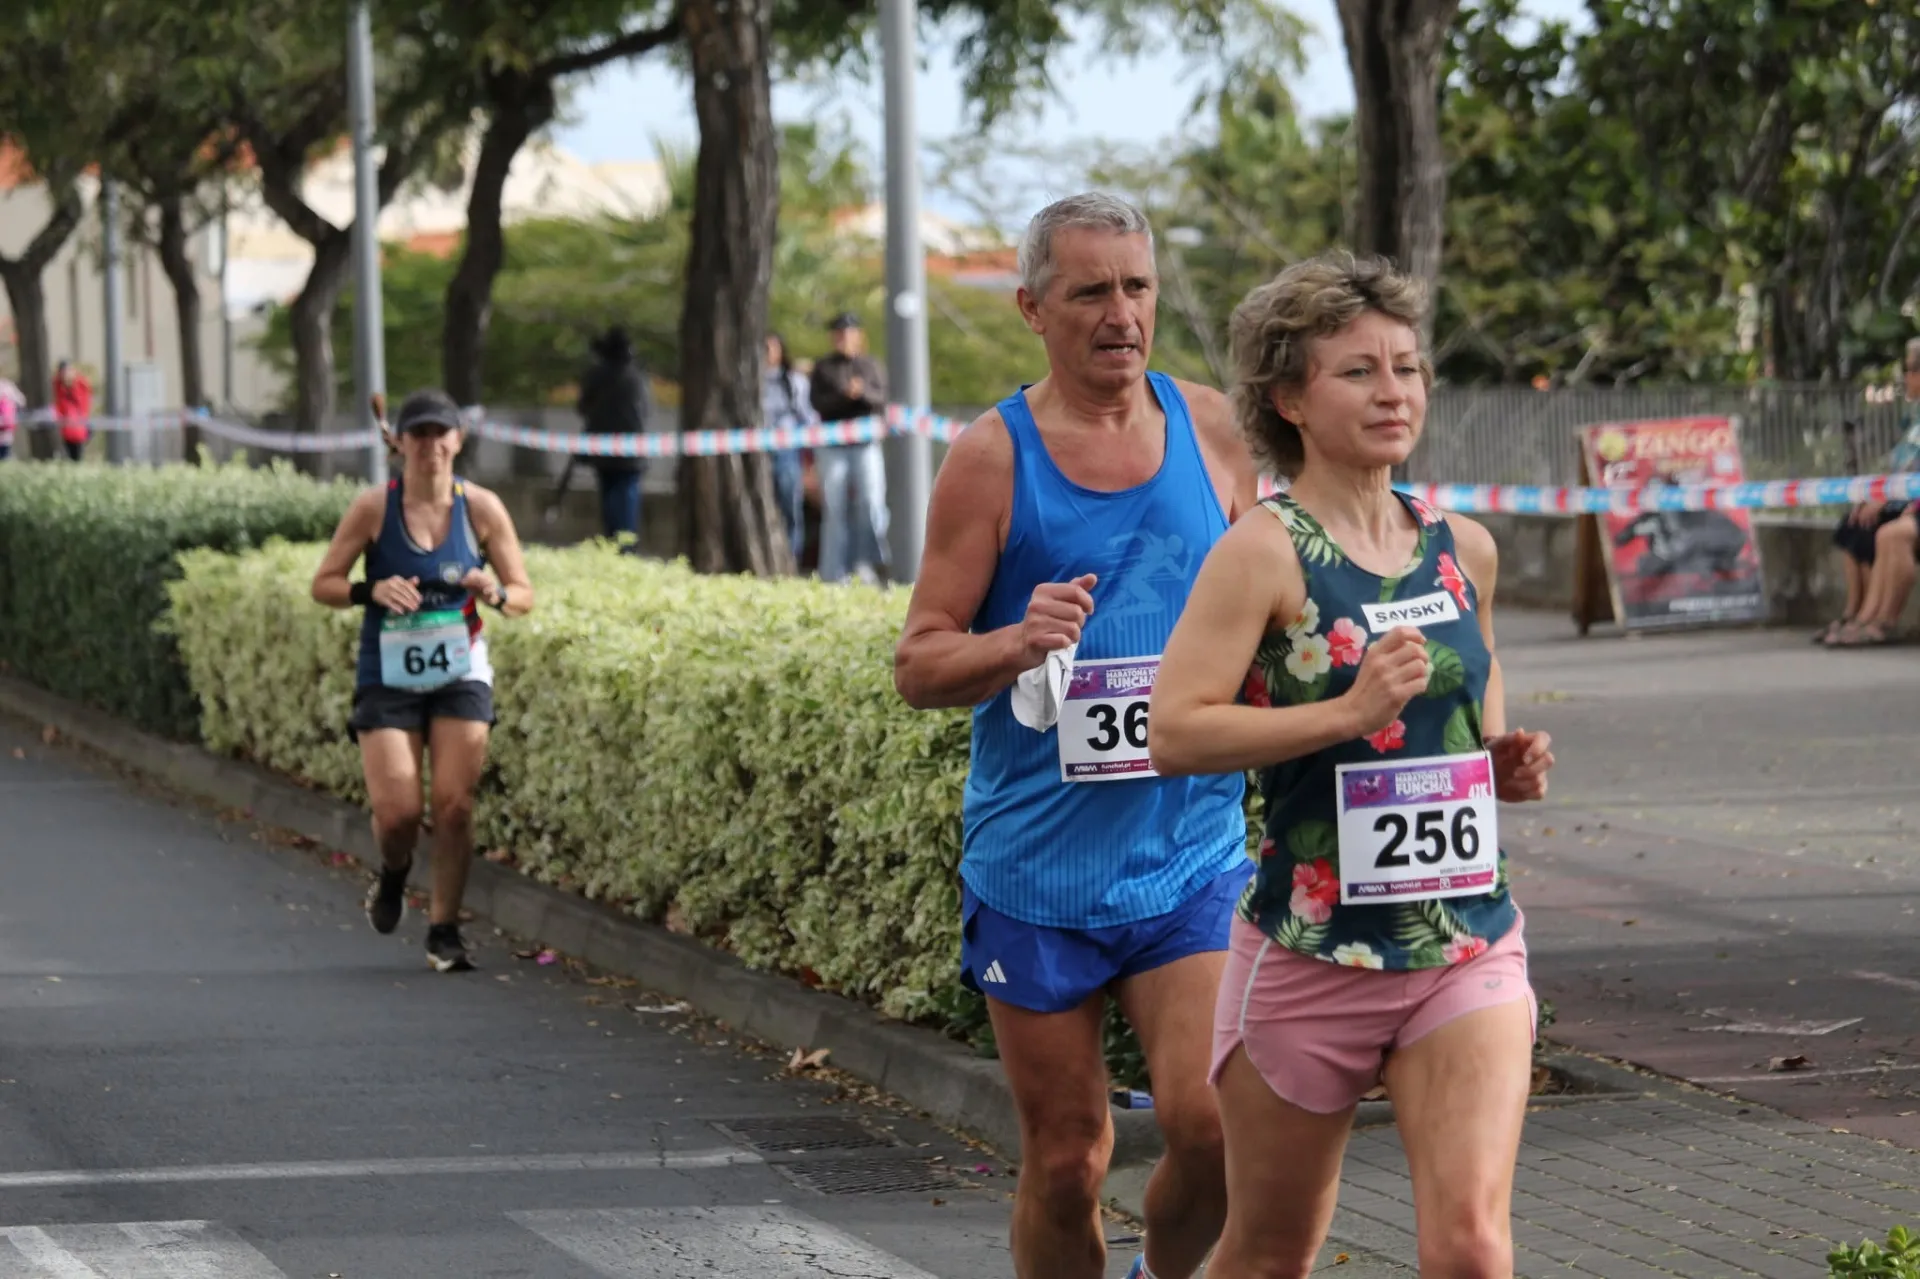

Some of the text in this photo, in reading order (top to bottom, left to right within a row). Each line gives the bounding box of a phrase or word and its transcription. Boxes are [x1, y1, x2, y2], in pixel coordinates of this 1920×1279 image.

[1634, 428, 1732, 460] TANGO
[1374, 601, 1445, 623] SAYSKY
[404, 641, 450, 675] 64
[1106, 676, 1156, 689] FUNCHA
[1395, 777, 1455, 796] FUNCHAL
[1373, 806, 1479, 868] 256
